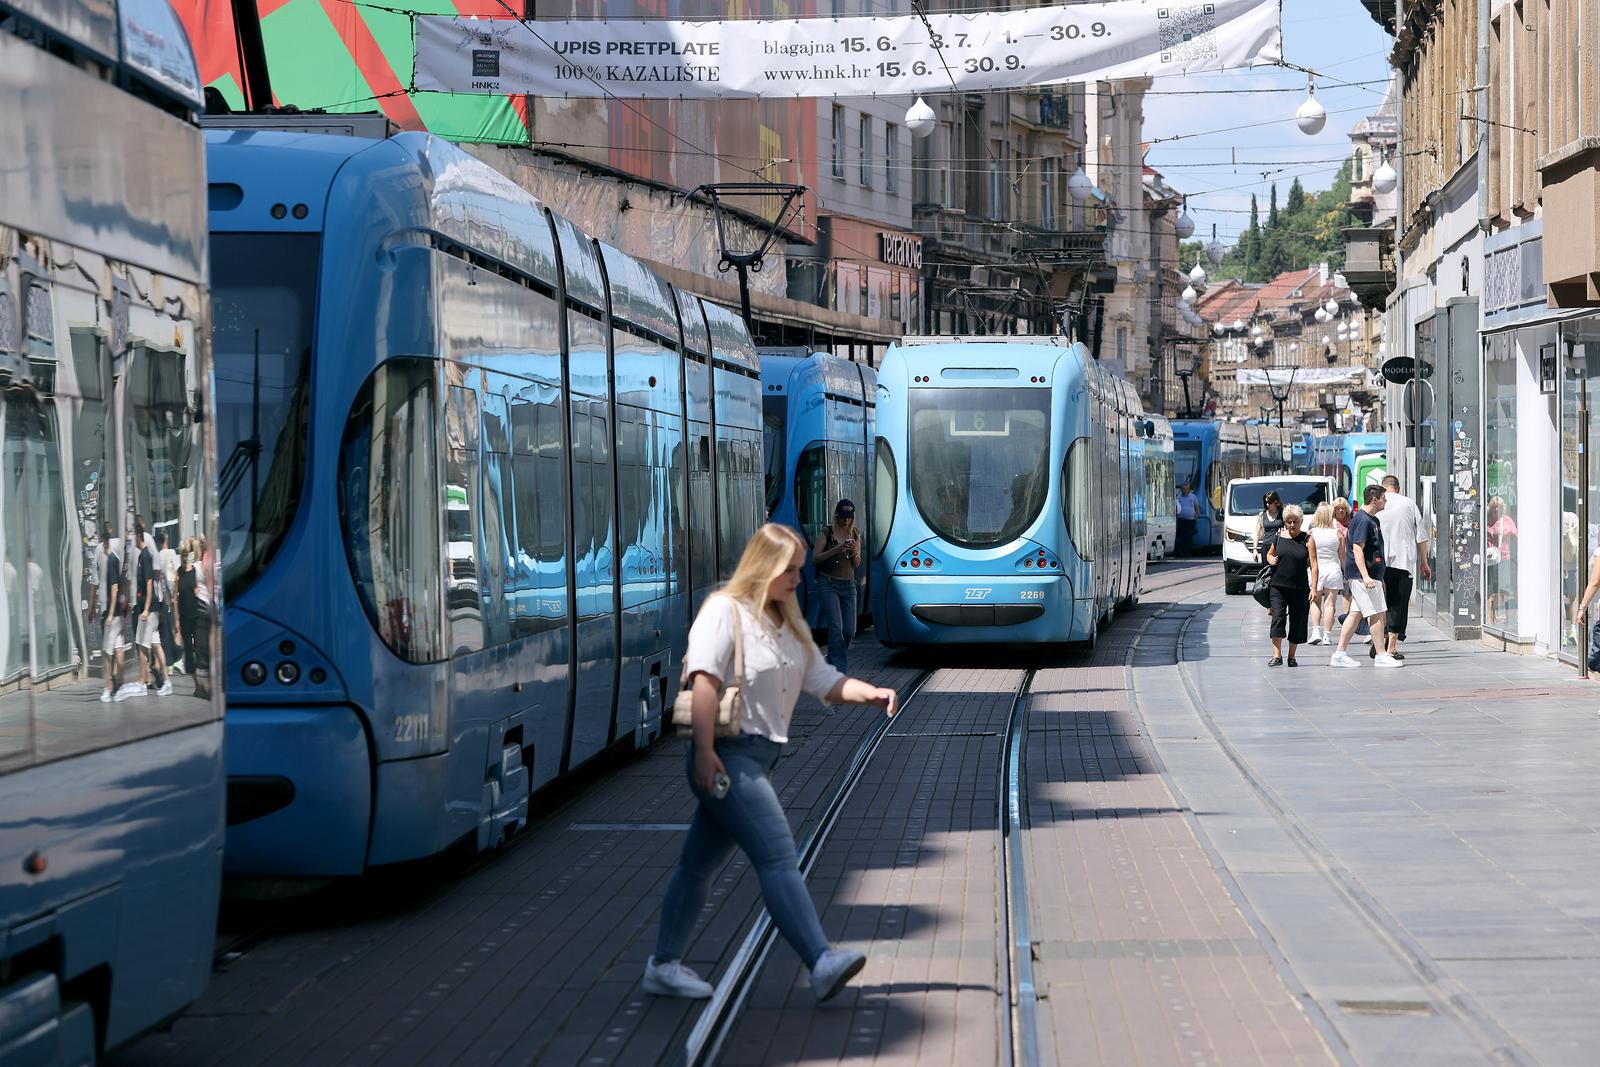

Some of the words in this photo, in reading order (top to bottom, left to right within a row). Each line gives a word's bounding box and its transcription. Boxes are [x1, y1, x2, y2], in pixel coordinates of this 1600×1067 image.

[554, 41, 601, 55] UPIS
[606, 41, 720, 55] PRETPLATE
[763, 40, 835, 57] blagajna
[554, 65, 583, 80] 100
[606, 63, 720, 81] KAZALIŠTE
[764, 64, 871, 80] www.hnk.hr
[965, 588, 992, 600] ZET
[1020, 591, 1045, 600] 2269
